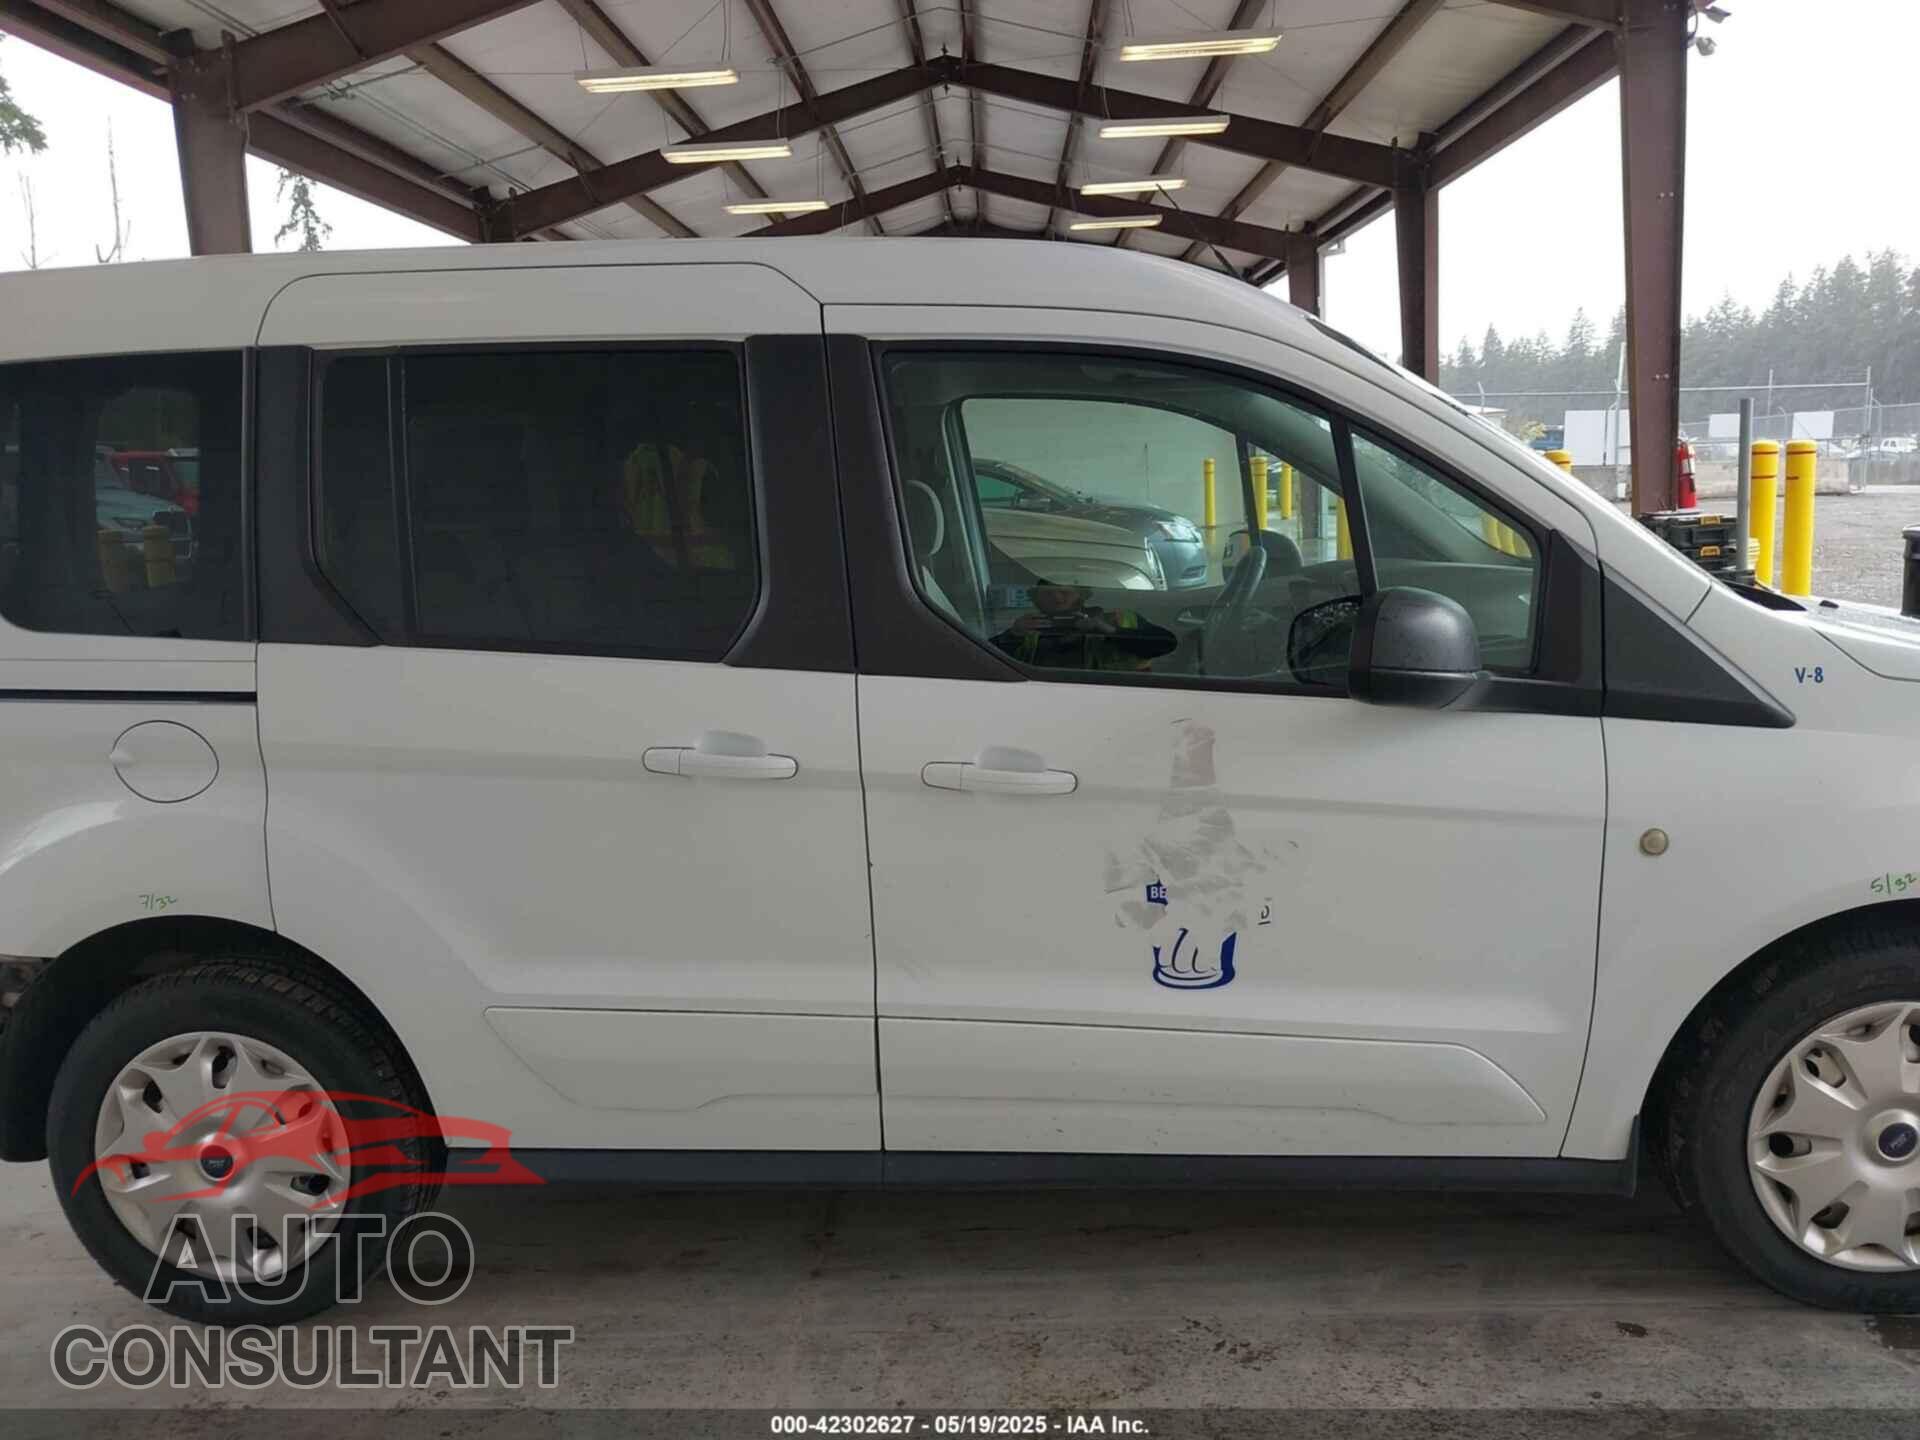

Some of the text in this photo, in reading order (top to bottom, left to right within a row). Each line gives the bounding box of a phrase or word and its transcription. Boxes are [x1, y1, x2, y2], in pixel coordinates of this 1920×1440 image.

[1794, 666, 1824, 684] V-8
[1870, 872, 1918, 896] 5/32
[138, 892, 179, 911] 7/32
